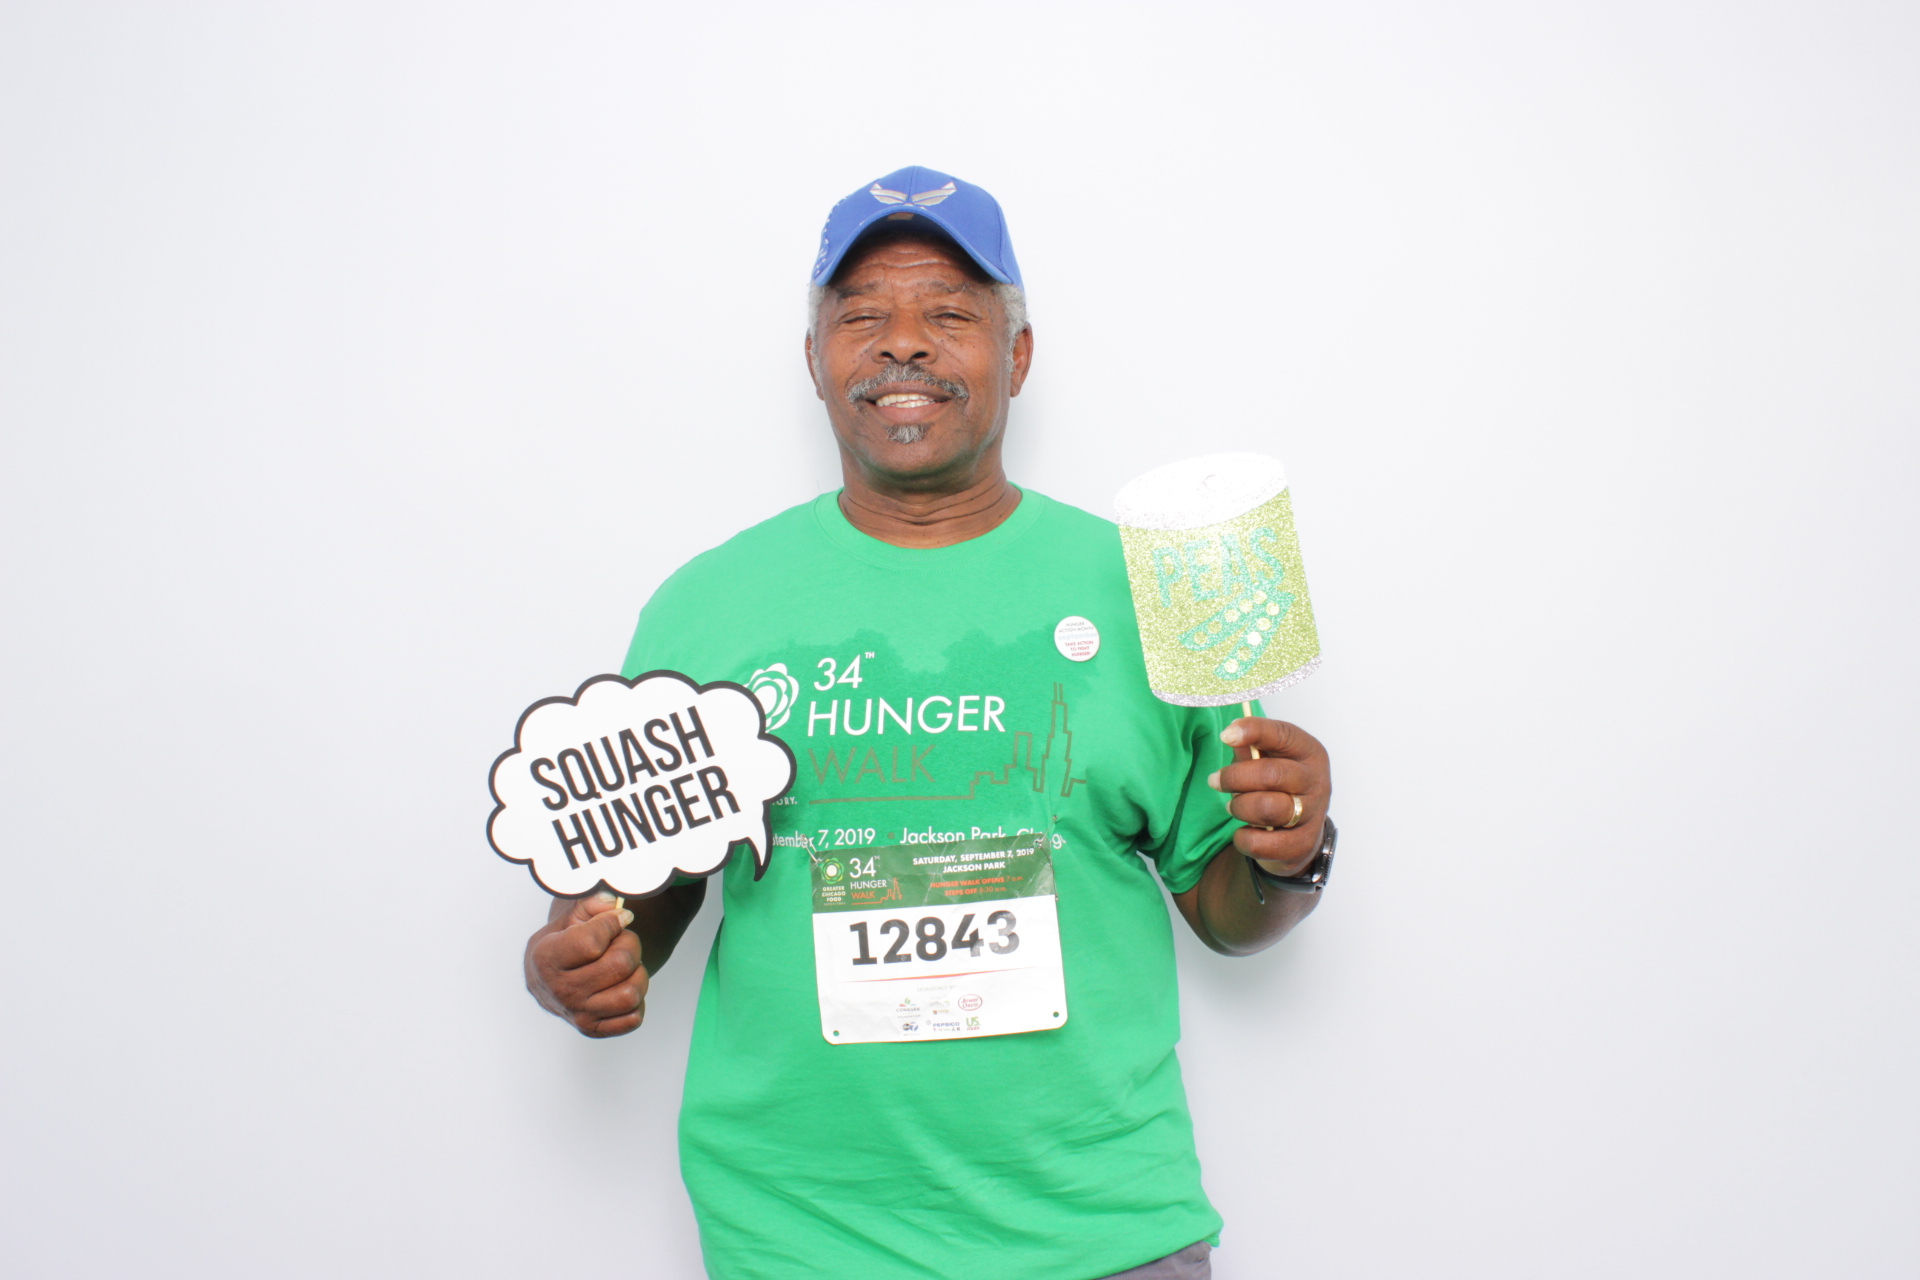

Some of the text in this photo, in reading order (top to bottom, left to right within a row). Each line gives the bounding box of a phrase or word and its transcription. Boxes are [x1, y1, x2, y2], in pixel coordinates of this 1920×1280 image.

[1151, 526, 1284, 608] PEAS
[806, 695, 1006, 737] HUNGER
[529, 705, 715, 811] SQUASH
[807, 744, 936, 785] WALK
[551, 765, 741, 870] HUNGER
[818, 829, 830, 849] 7,
[834, 828, 876, 846] 2019
[900, 826, 966, 844] Jackson
[913, 848, 1034, 866] SATURDAY, SEPTEMBER 7, 2019
[942, 861, 1006, 874] JACKSON PARK
[850, 880, 888, 890] HUNGER
[851, 890, 876, 900] WALK
[930, 880, 959, 889] HUNGER
[960, 879, 980, 887] WALK
[850, 910, 1020, 966] 12843
